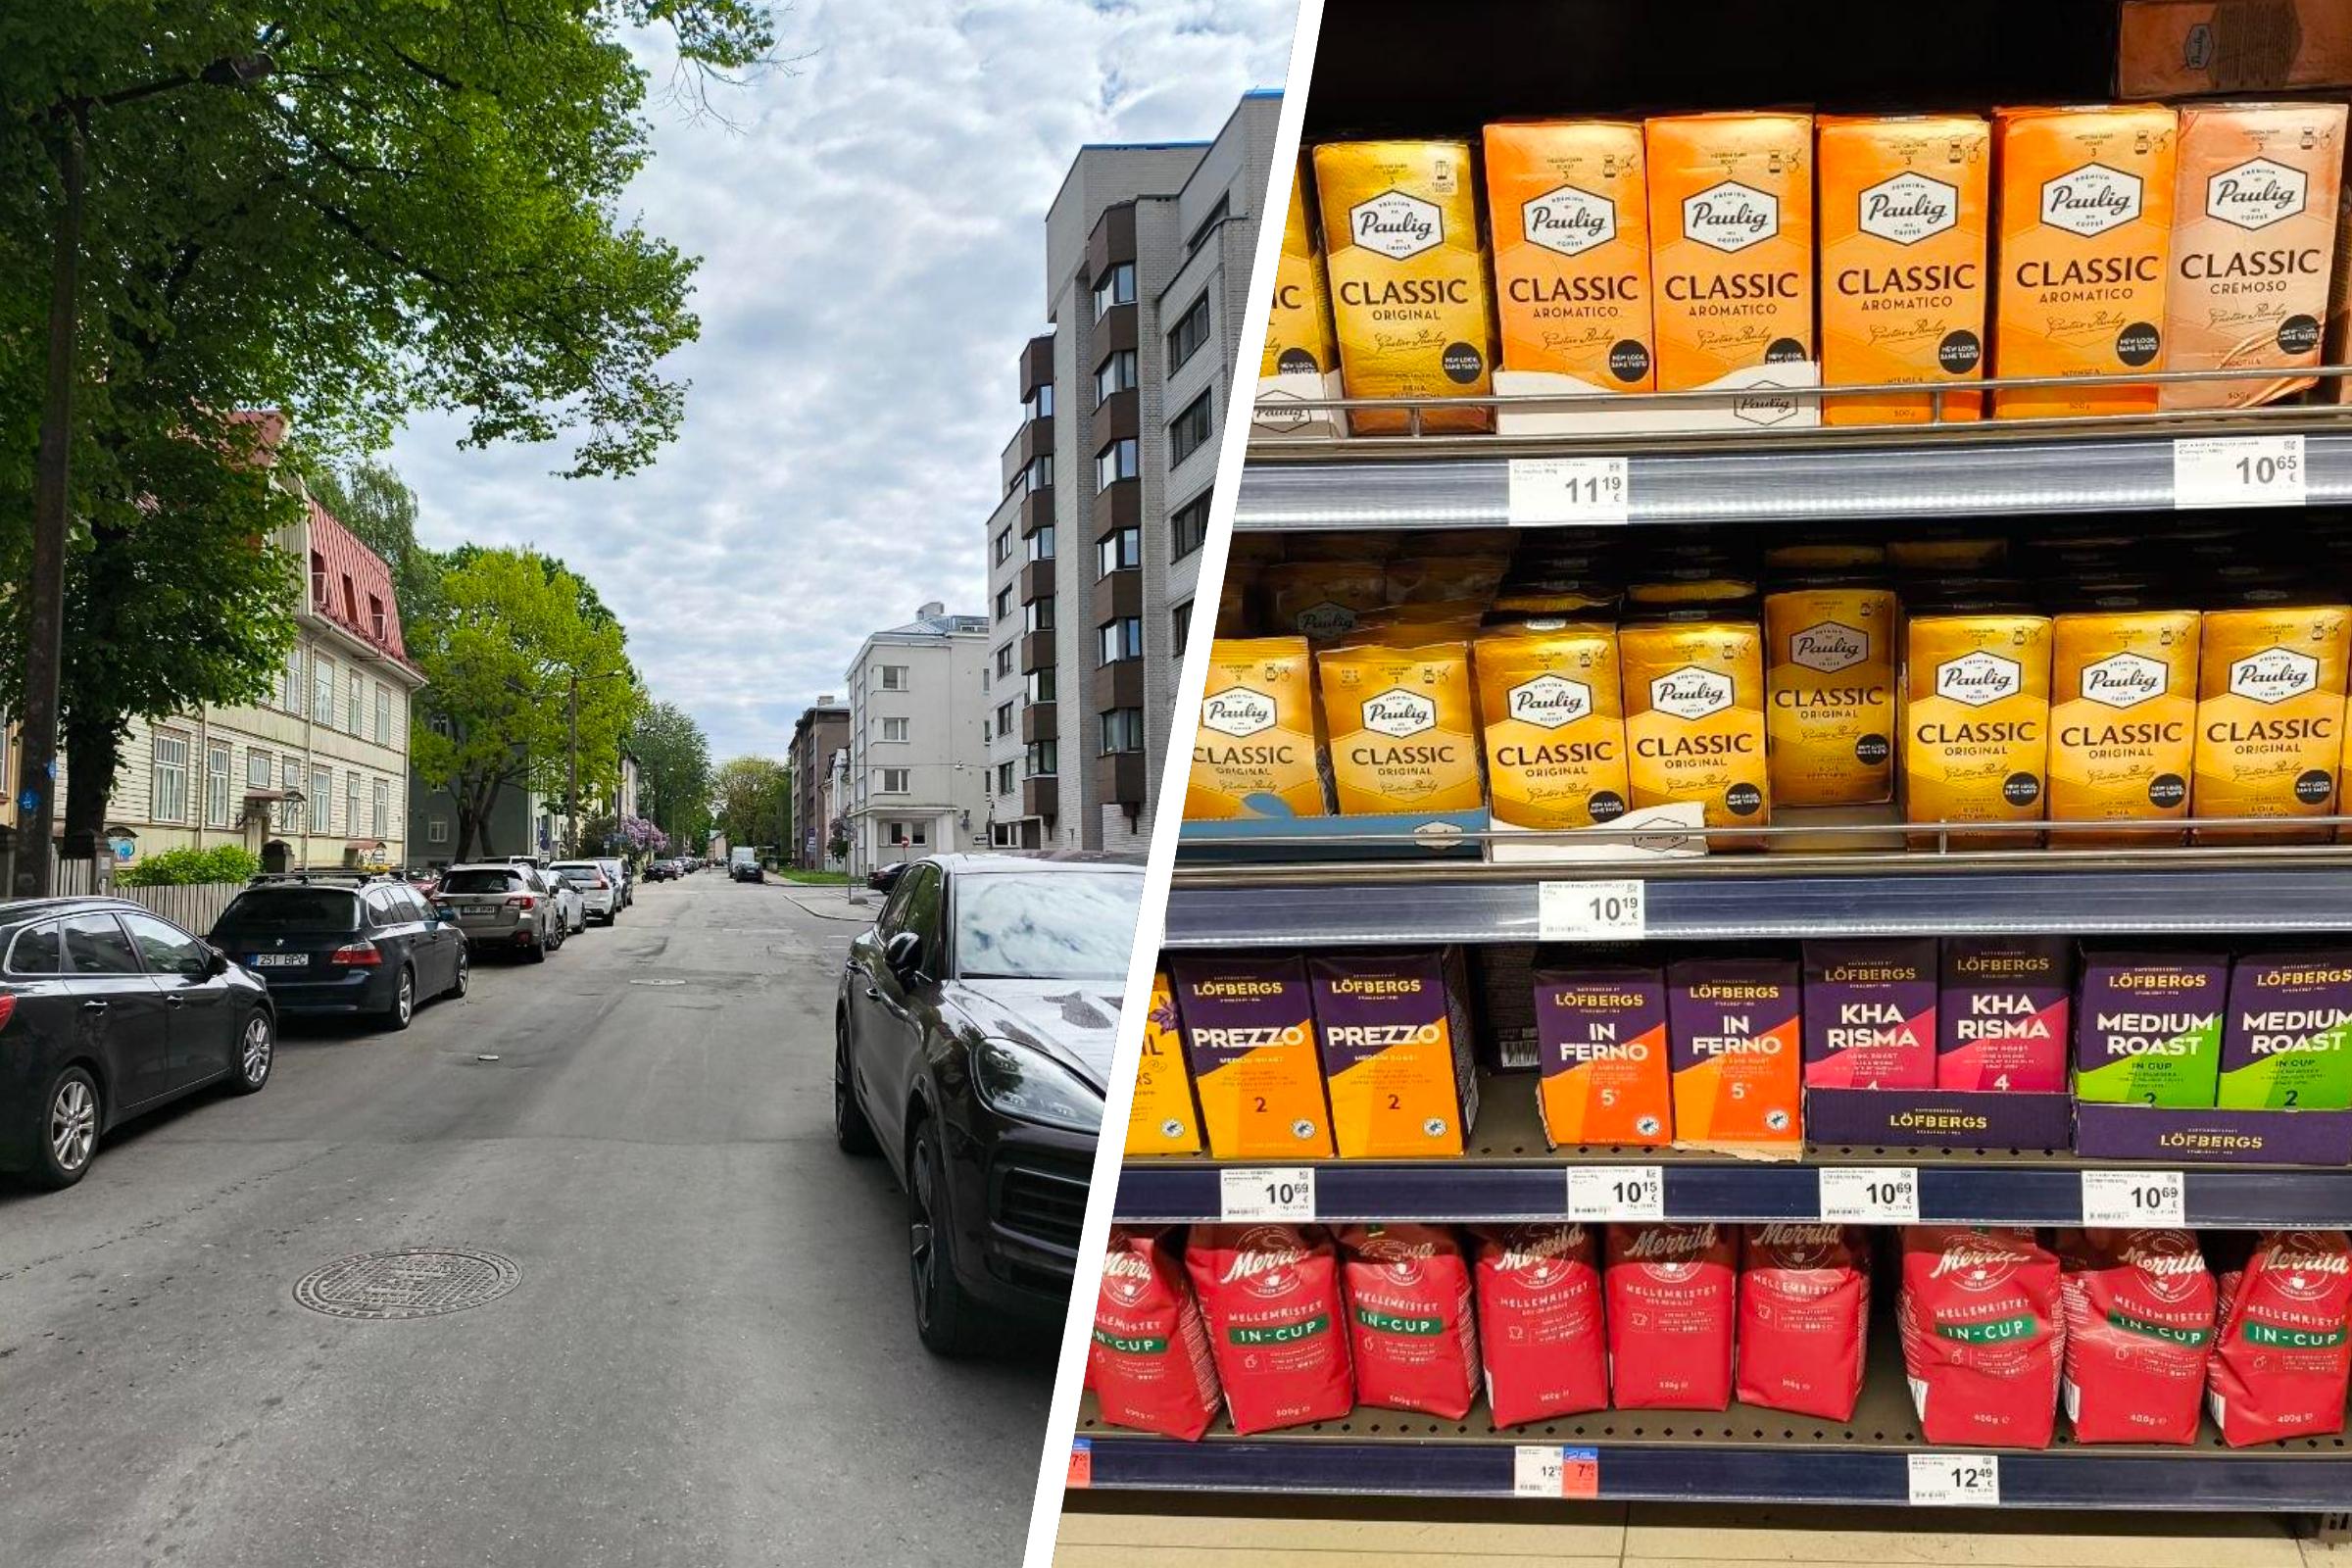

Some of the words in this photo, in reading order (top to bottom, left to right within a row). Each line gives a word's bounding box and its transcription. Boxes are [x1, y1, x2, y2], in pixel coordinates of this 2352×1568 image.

[2050, 185, 2132, 216] Paulig
[2217, 179, 2296, 210] Paulig
[1692, 202, 1769, 232] Paulig
[1868, 194, 1948, 223] Paulig
[1359, 210, 1434, 239] Paulig
[1533, 207, 1606, 236] Paulig
[2016, 255, 2158, 288] CLASSIC
[2180, 249, 2322, 280] CLASSIC
[1508, 275, 1639, 303] CLASSIC
[1665, 272, 1799, 301] CLASSIC
[1838, 264, 1976, 296] CLASSIC
[2210, 280, 2287, 295] CREMOSO
[1340, 278, 1468, 306] CLASSIC
[2039, 288, 2133, 303] AROMATICO
[1533, 307, 1618, 318] AROMATICO
[1688, 305, 1778, 317] AROMATICO
[1862, 296, 1953, 312] AROMATICO
[1372, 309, 1441, 320] ORIGINAL
[1797, 637, 1859, 659] Paulig
[1943, 667, 2012, 691] Paulig
[2088, 669, 2159, 692] Paulig
[2237, 664, 2310, 688] Paulig
[1517, 691, 1584, 713] Paulig
[1658, 682, 1726, 705] Paulig
[1775, 686, 1885, 709] CLASSIC
[1208, 700, 1270, 724] Paulig
[1369, 703, 1430, 725] Paulig
[1800, 710, 1858, 719] ORIGINAL
[1917, 722, 2035, 744] CLASSIC
[2061, 722, 2182, 748] CLASSIC
[2207, 718, 2331, 743] CLASSIC
[1193, 746, 1295, 765] CLASSIC
[1351, 746, 1455, 766] CLASSIC
[1496, 741, 1614, 766] CLASSIC
[1637, 733, 1753, 759] CLASSIC
[1944, 746, 2008, 757] ORIGINAL
[2088, 747, 2154, 760] ORIGINAL
[2234, 743, 2301, 756] ORIGINAL
[1215, 766, 1273, 776] ORIGINAL
[1378, 767, 1433, 776] ORIGINAL
[1525, 766, 1589, 777] ORIGINAL
[1664, 759, 1728, 769] ORIGINAL
[1825, 966, 1916, 982] LÖFBERGS
[1957, 956, 2049, 972] LÖFBERGS
[1332, 979, 1421, 995] LÖFBERGS
[2110, 973, 2206, 989] LÖFBERGS
[2257, 969, 2352, 987] LÖFBERGS
[1193, 981, 1283, 997] LÖFBERGS
[1690, 983, 1780, 999] LÖFBERGS
[1555, 992, 1643, 1007] LÖFBERGS
[1972, 994, 2036, 1015] KHA
[1840, 1004, 1905, 1024] KHA
[2097, 1013, 2215, 1033] MEDIUM
[2243, 1009, 2352, 1031] MEDIUM
[1589, 1023, 1615, 1041] IN
[1723, 1015, 1749, 1034] IN
[1958, 1019, 2050, 1039] RISMA
[1193, 1027, 1304, 1049] PREZZO
[1327, 1025, 1441, 1046] PREZZO
[1828, 1029, 1919, 1049] RISMA
[2107, 1036, 2203, 1055] ROAST
[2251, 1032, 2347, 1054] ROAST
[1560, 1043, 1647, 1061] FERNO
[1692, 1037, 1782, 1055] FERNO
[1732, 1082, 1744, 1100] 5
[1993, 1074, 2009, 1091] 4
[1254, 1097, 1268, 1113] 2
[1388, 1094, 1400, 1110] 2
[1601, 1088, 1615, 1106] 5
[2283, 1090, 2299, 1106] 2
[1890, 1112, 1987, 1129] LÖFBERGS
[2161, 1133, 2263, 1149] LÖFBERGS
[1624, 1223, 1717, 1256] Merrild
[1102, 1252, 1152, 1280] Merri
[1355, 1291, 1439, 1311] MELLEMRISTET
[1499, 1281, 1589, 1308] MELLEMRISTET
[1626, 1284, 1717, 1299] MELLEMRISTET
[1229, 1300, 1323, 1321] MELLEMRISTET
[1936, 1298, 2030, 1319] MELLEMRISTET
[2114, 1295, 2212, 1323] MELLEMRISTET
[1240, 1321, 1316, 1343] IN-CUP
[1362, 1313, 1431, 1333] IN-CUP
[1947, 1321, 2025, 1341] IN-CUP
[2121, 1317, 2202, 1345] IN-CUP
[2255, 1326, 2338, 1347] IN-CUP
[1951, 1468, 1979, 1488] 12
